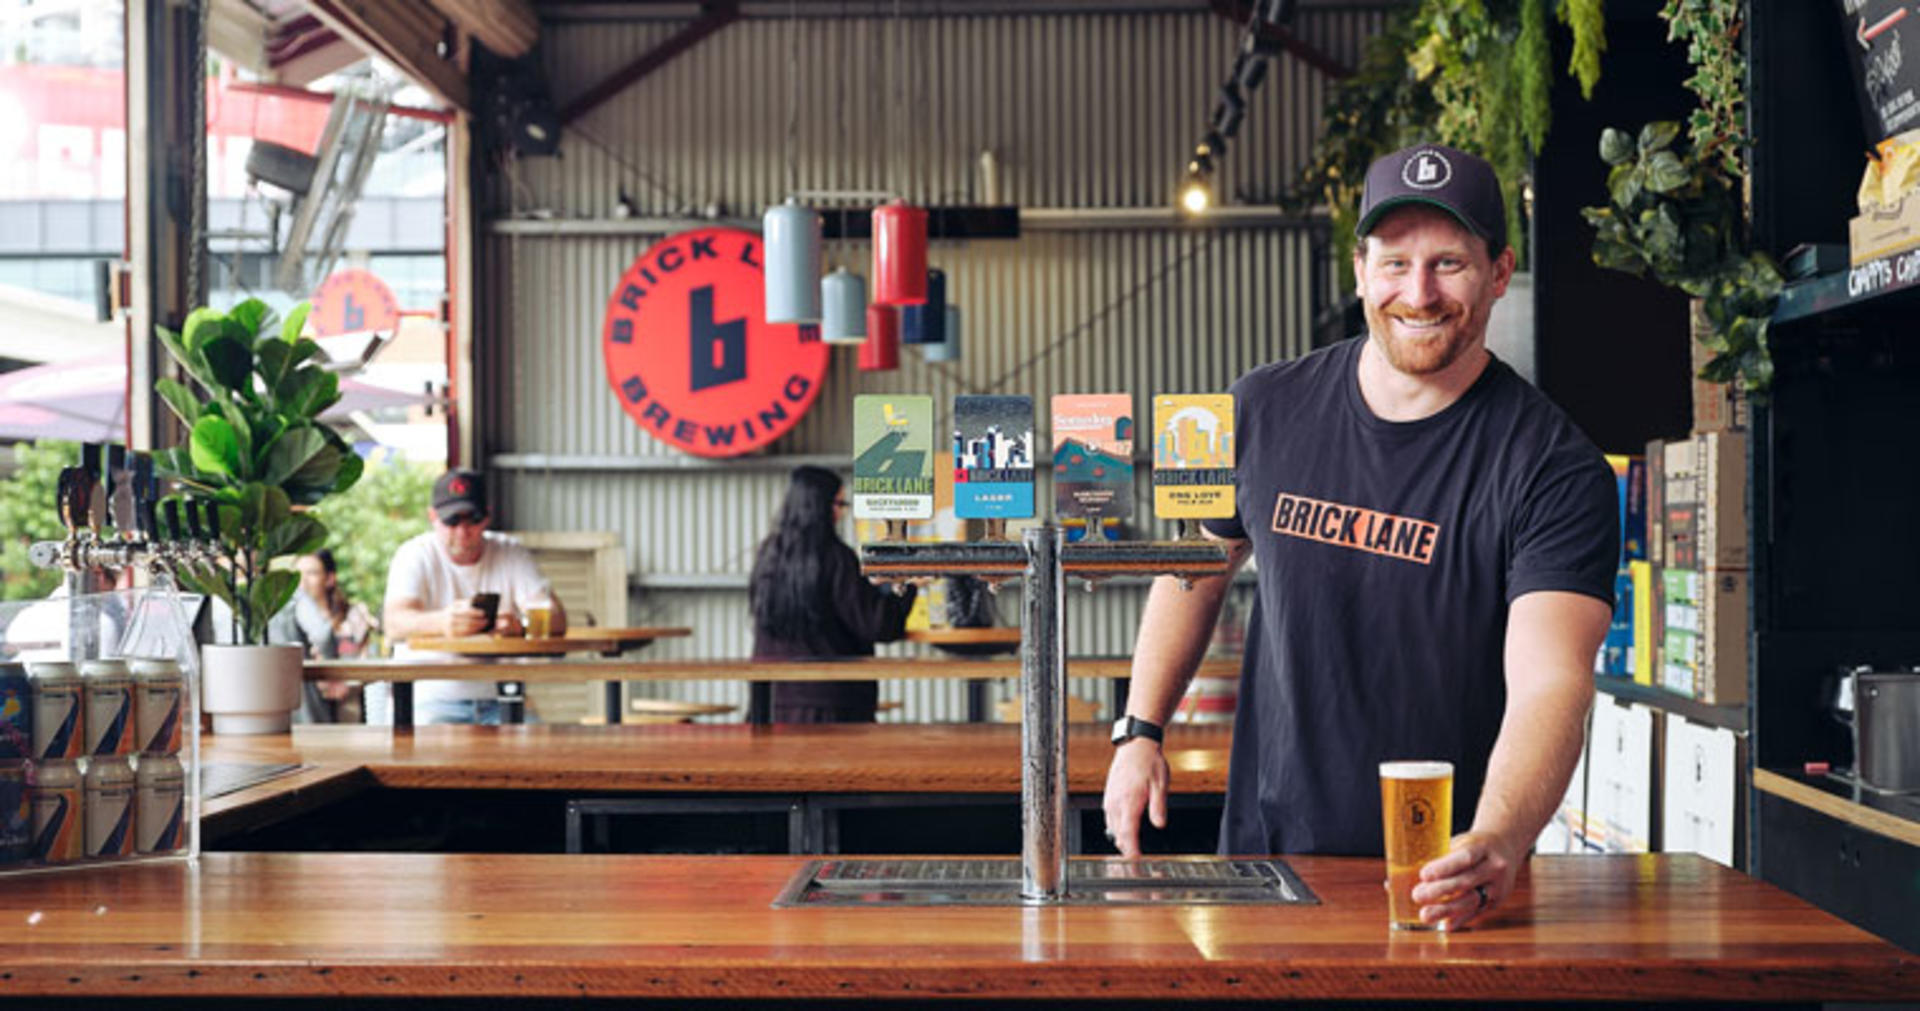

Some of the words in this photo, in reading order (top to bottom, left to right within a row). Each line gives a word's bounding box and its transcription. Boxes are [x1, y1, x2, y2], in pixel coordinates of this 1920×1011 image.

[611, 235, 718, 344] BRICK
[740, 243, 821, 344] LE
[690, 284, 748, 393] b
[621, 374, 810, 446] BREWING
[854, 477, 895, 493] BRICK
[896, 477, 932, 493] LANE
[973, 493, 1012, 502] LAGER
[1154, 469, 1197, 485] BRICK
[1275, 497, 1362, 543] BRICK
[1363, 513, 1435, 560] LANE
